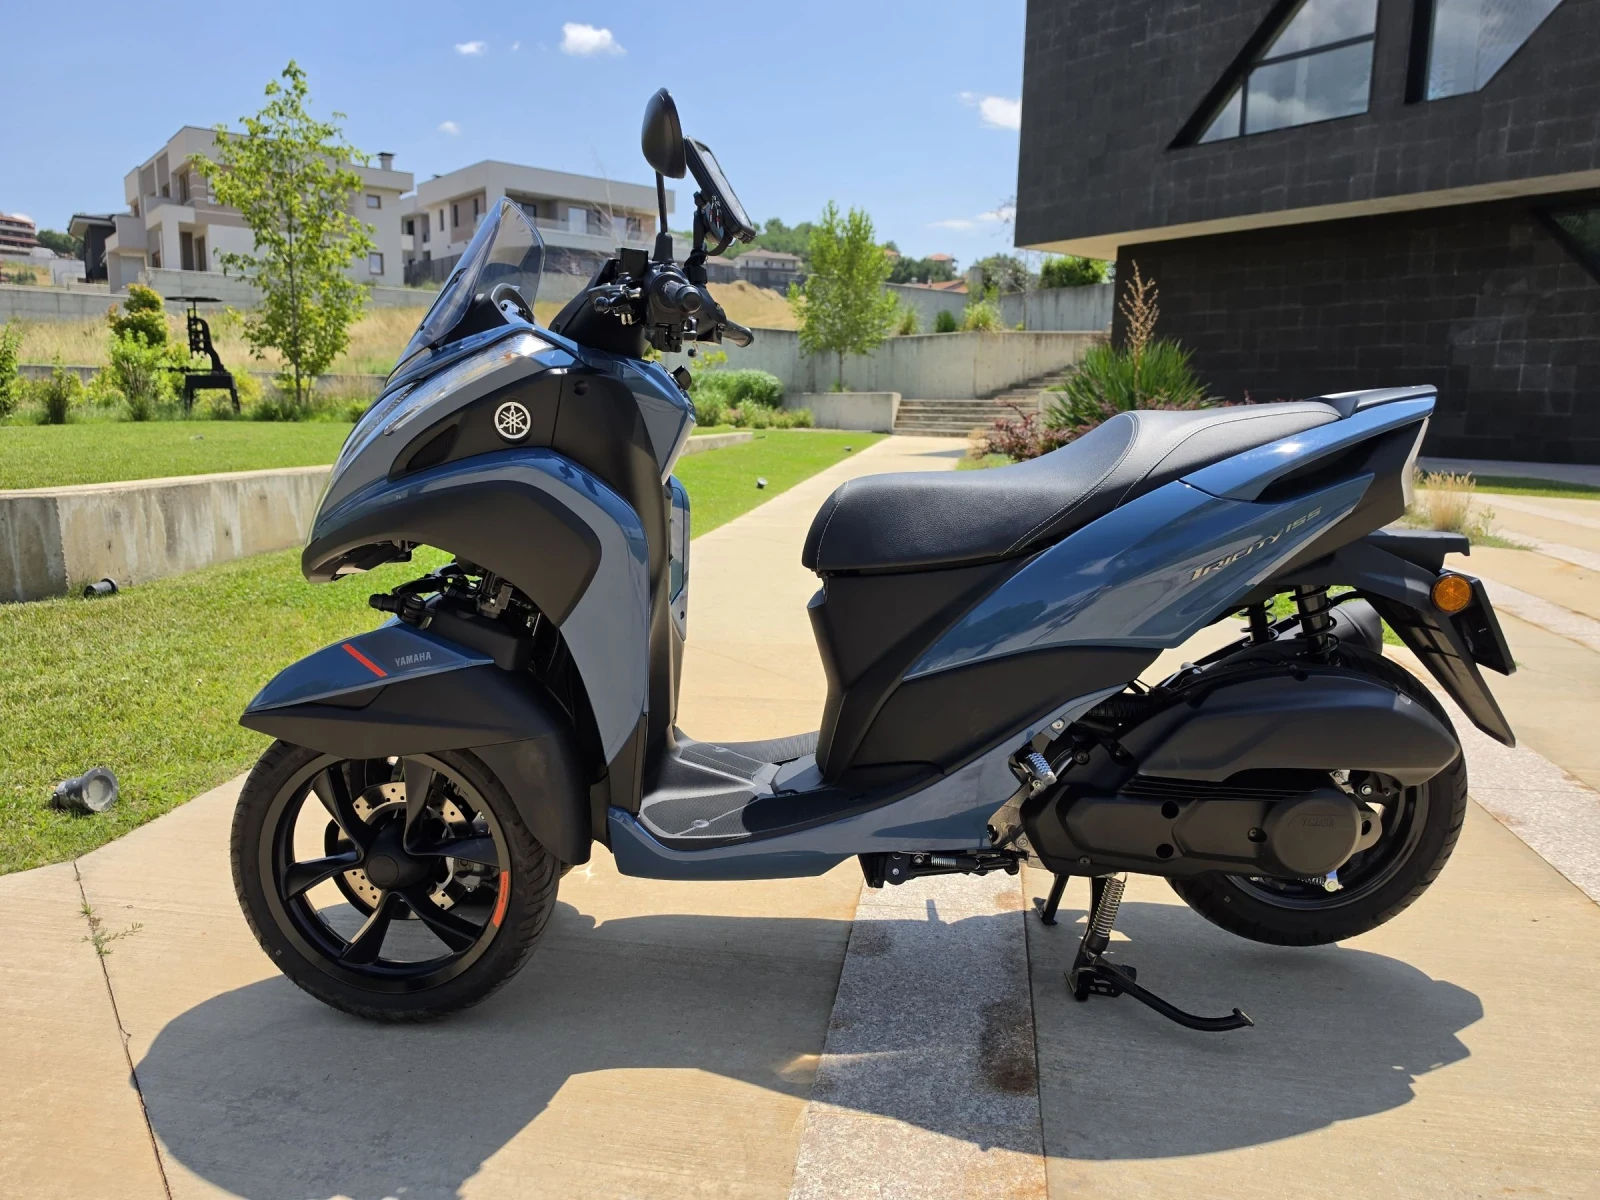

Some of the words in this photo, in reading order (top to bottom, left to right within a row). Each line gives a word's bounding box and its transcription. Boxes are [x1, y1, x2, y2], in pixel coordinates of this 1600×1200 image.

[1187, 528, 1284, 581] TRICITY
[1285, 506, 1322, 533] 155
[395, 651, 432, 667] YAMAHA
